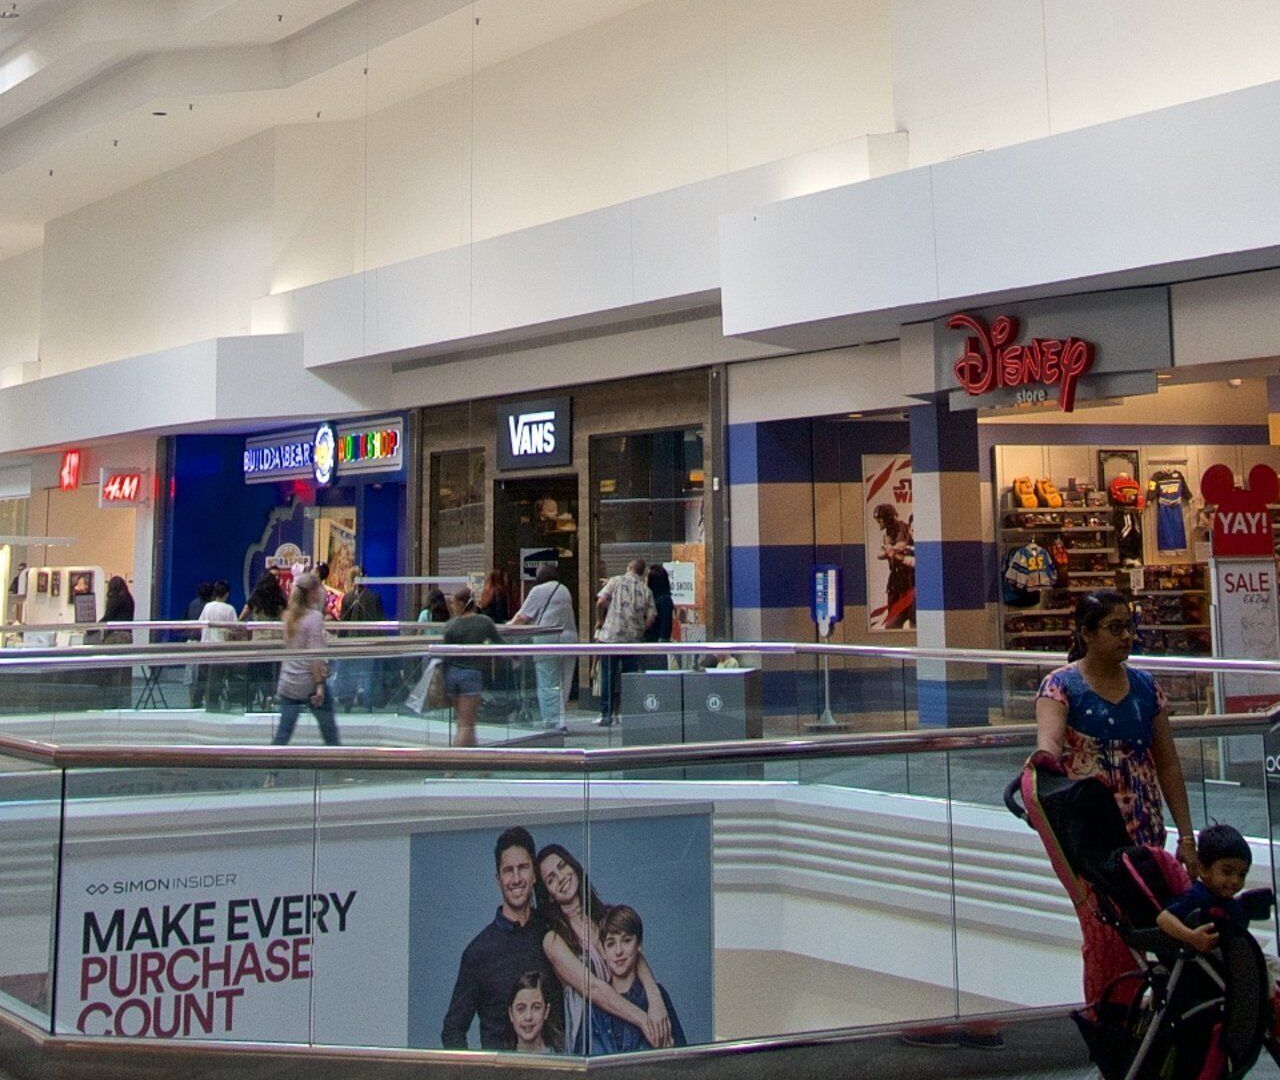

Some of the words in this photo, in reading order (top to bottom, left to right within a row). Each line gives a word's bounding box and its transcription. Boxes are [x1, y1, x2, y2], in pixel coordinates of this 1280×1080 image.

[1016, 388, 1046, 403] store
[509, 411, 555, 456] VANS
[103, 473, 141, 502] H&M
[1219, 512, 1268, 535] YAY!
[1224, 572, 1270, 594] SALE
[113, 878, 170, 894] SIMON
[172, 873, 237, 889] INSIDER
[82, 901, 216, 954] MAKE
[227, 890, 357, 941] EVERY
[80, 937, 313, 1001] PURCHASE
[76, 988, 244, 1039] COUNT
